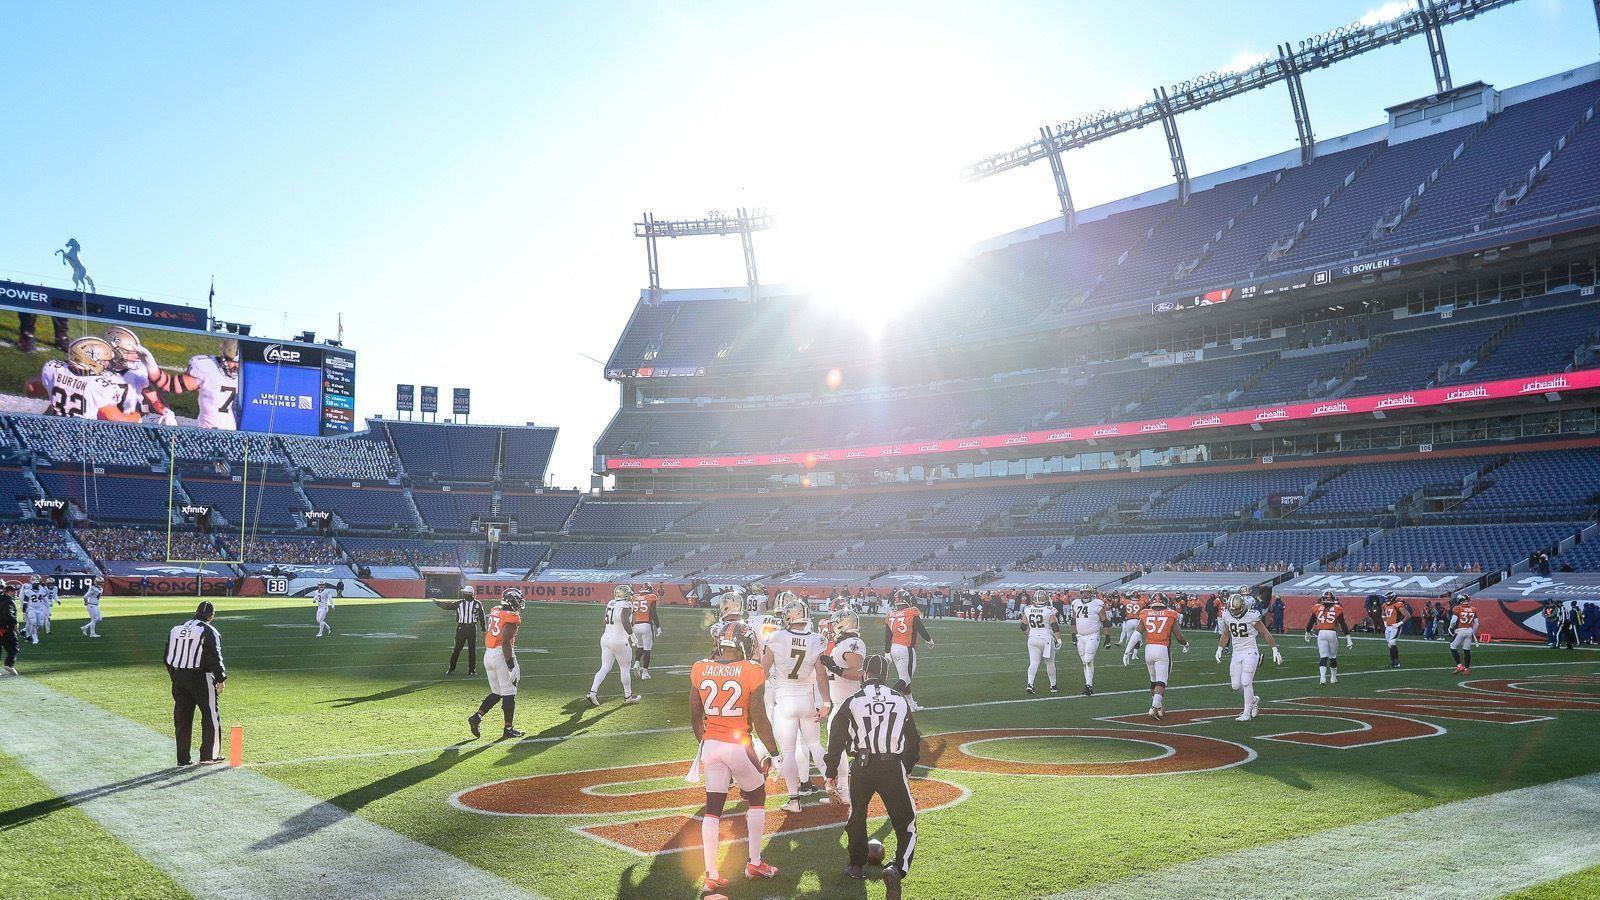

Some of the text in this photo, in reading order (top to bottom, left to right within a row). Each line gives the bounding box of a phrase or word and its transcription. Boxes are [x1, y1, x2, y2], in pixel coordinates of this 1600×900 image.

[1352, 260, 1389, 273] BOWLEN
[1194, 296, 1200, 306] 6
[118, 304, 152, 317] FIELD
[269, 349, 300, 359] ACP
[56, 373, 88, 391] BURTON
[1522, 377, 1567, 391] uchealth
[218, 385, 237, 413] 7
[261, 393, 296, 401] UNITED
[1446, 386, 1487, 400] uchealth
[51, 386, 86, 418] 32
[252, 399, 296, 408] AIRLINES
[1377, 395, 1415, 407] uchealth
[1314, 402, 1348, 414] uchealth
[1255, 409, 1287, 421] uchealth
[1139, 421, 1169, 432] uchealth
[1191, 416, 1221, 427] uchealth
[1047, 431, 1073, 442] uchealth
[1093, 426, 1120, 437] uchealth
[34, 499, 65, 510] xfinity
[182, 505, 209, 515] xfinity
[305, 510, 329, 520] xfinity
[58, 578, 93, 590] 10:19
[129, 581, 227, 593] BRONCOS
[271, 580, 286, 592] 38
[1293, 575, 1459, 589] IKON
[31, 594, 43, 603] 24
[317, 594, 322, 603] 3
[1076, 606, 1089, 618] 74
[1126, 603, 1140, 614] 59
[1028, 614, 1046, 629] 62
[1317, 610, 1336, 624] 45
[1459, 611, 1475, 624] 37
[889, 617, 908, 634] 73
[1145, 616, 1168, 634] 57
[1229, 622, 1249, 638] 82
[791, 637, 807, 647] HILL
[787, 648, 806, 680] 7
[701, 665, 743, 677] JACKSON
[700, 679, 744, 717] 22
[864, 702, 897, 716] 107
